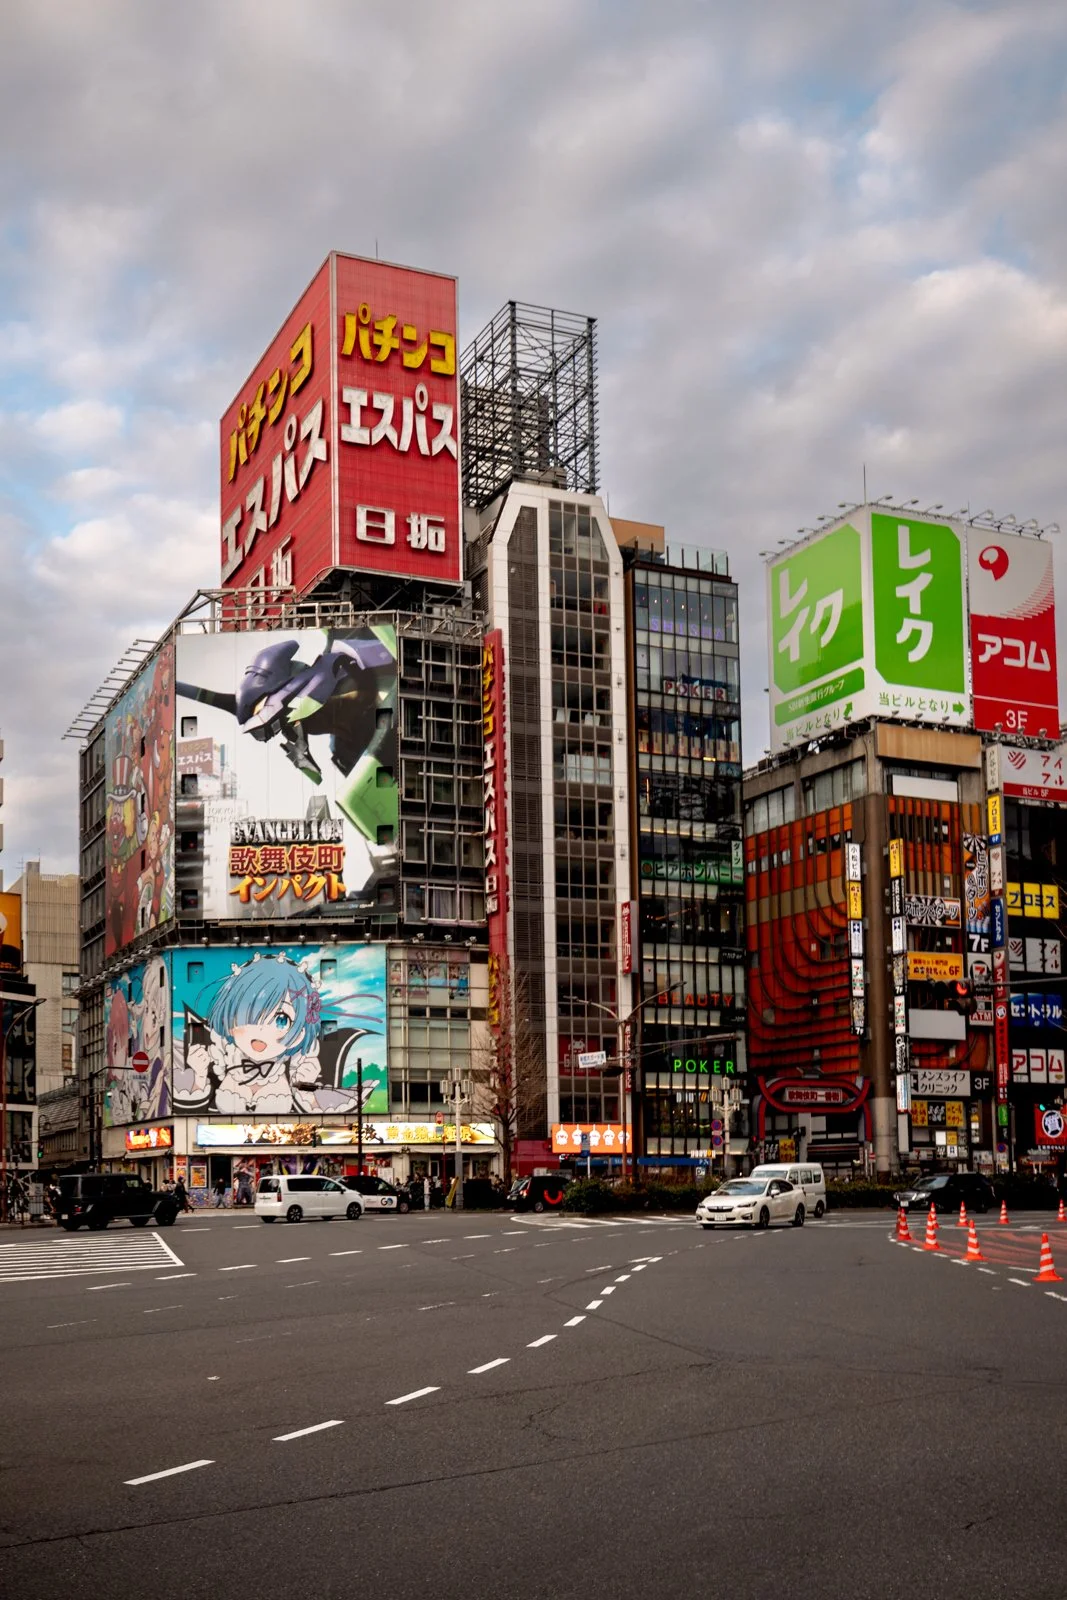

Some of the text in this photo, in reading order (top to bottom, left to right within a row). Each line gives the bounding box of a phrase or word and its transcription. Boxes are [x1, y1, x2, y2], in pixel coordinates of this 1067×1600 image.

[342, 302, 455, 375] パチンコ
[228, 322, 312, 483] パチンコ
[340, 383, 457, 460] エスパス
[221, 397, 327, 582] エスパス
[356, 504, 446, 552] 日拓
[896, 524, 934, 663] レイク
[778, 568, 844, 663] レイク
[650, 617, 725, 640] SHISHA
[977, 633, 1051, 672] アコム
[483, 643, 495, 737] パチンコ
[663, 679, 726, 701] POKER
[879, 690, 949, 713] 当ビルとなり
[785, 708, 840, 739] 当ビルとなり
[1006, 709, 1028, 729] 3F
[484, 743, 497, 868] エスパス
[230, 819, 343, 843] EVANGELION
[230, 844, 345, 874] 歌舞伎町
[229, 872, 346, 903] インパクト
[1009, 892, 1055, 907] プロミス
[968, 932, 989, 951] 7F
[658, 992, 733, 1008] BEAUTY
[1010, 1001, 1062, 1019] セントラル
[972, 1012, 992, 1021] ATM
[673, 1059, 735, 1074] POKER
[1012, 1054, 1063, 1071] アコム
[920, 1071, 966, 1082] メンズライフ
[974, 1077, 990, 1090] 3F
[920, 1083, 958, 1094] クリニック
